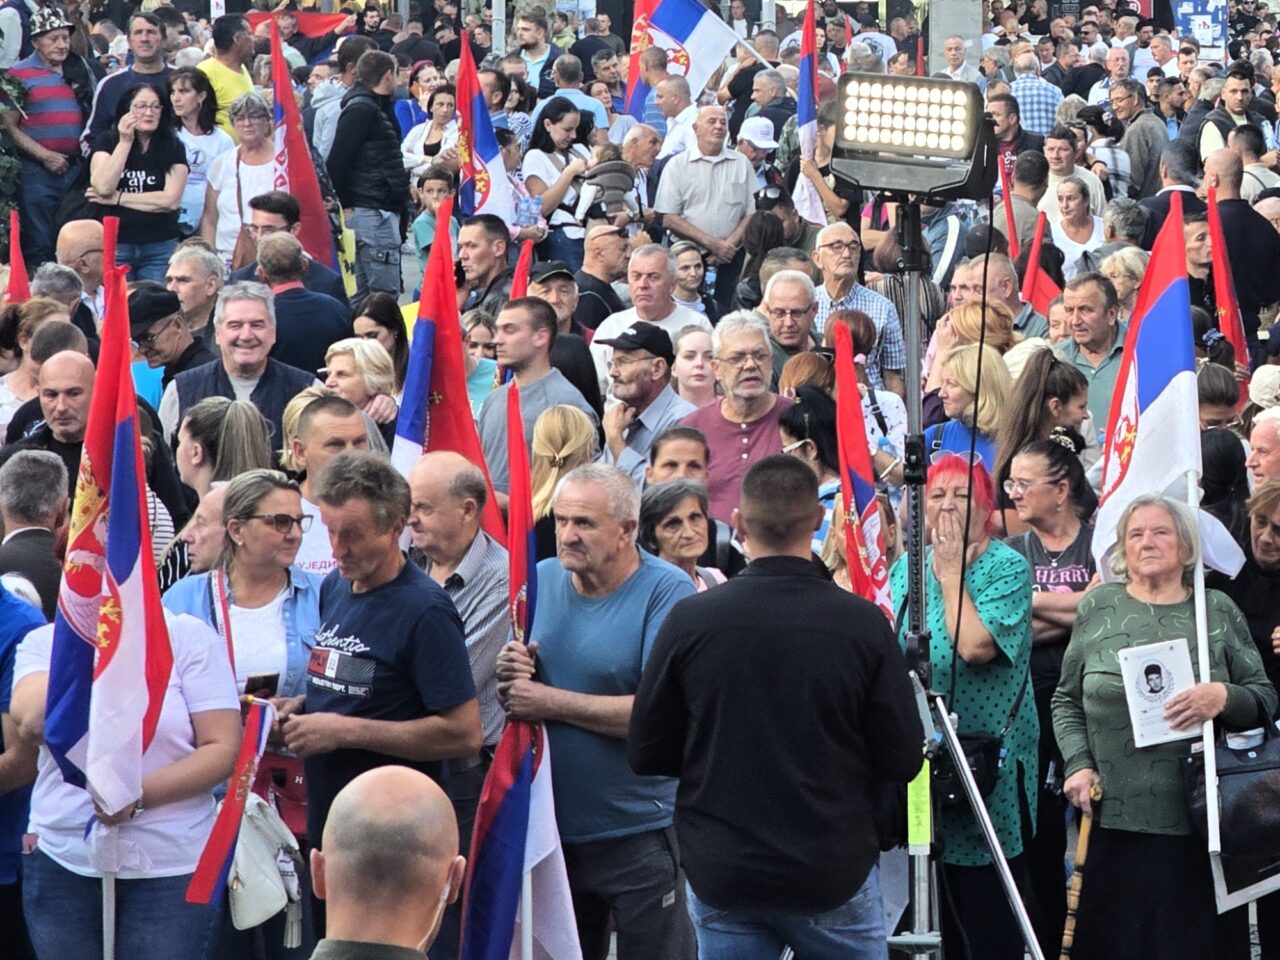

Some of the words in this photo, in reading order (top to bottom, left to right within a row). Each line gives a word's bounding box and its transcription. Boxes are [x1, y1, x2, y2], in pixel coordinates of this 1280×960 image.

[298, 560, 337, 570] УЈЕДИ
[1035, 568, 1090, 583] HERRY
[315, 622, 371, 653] uthentic
